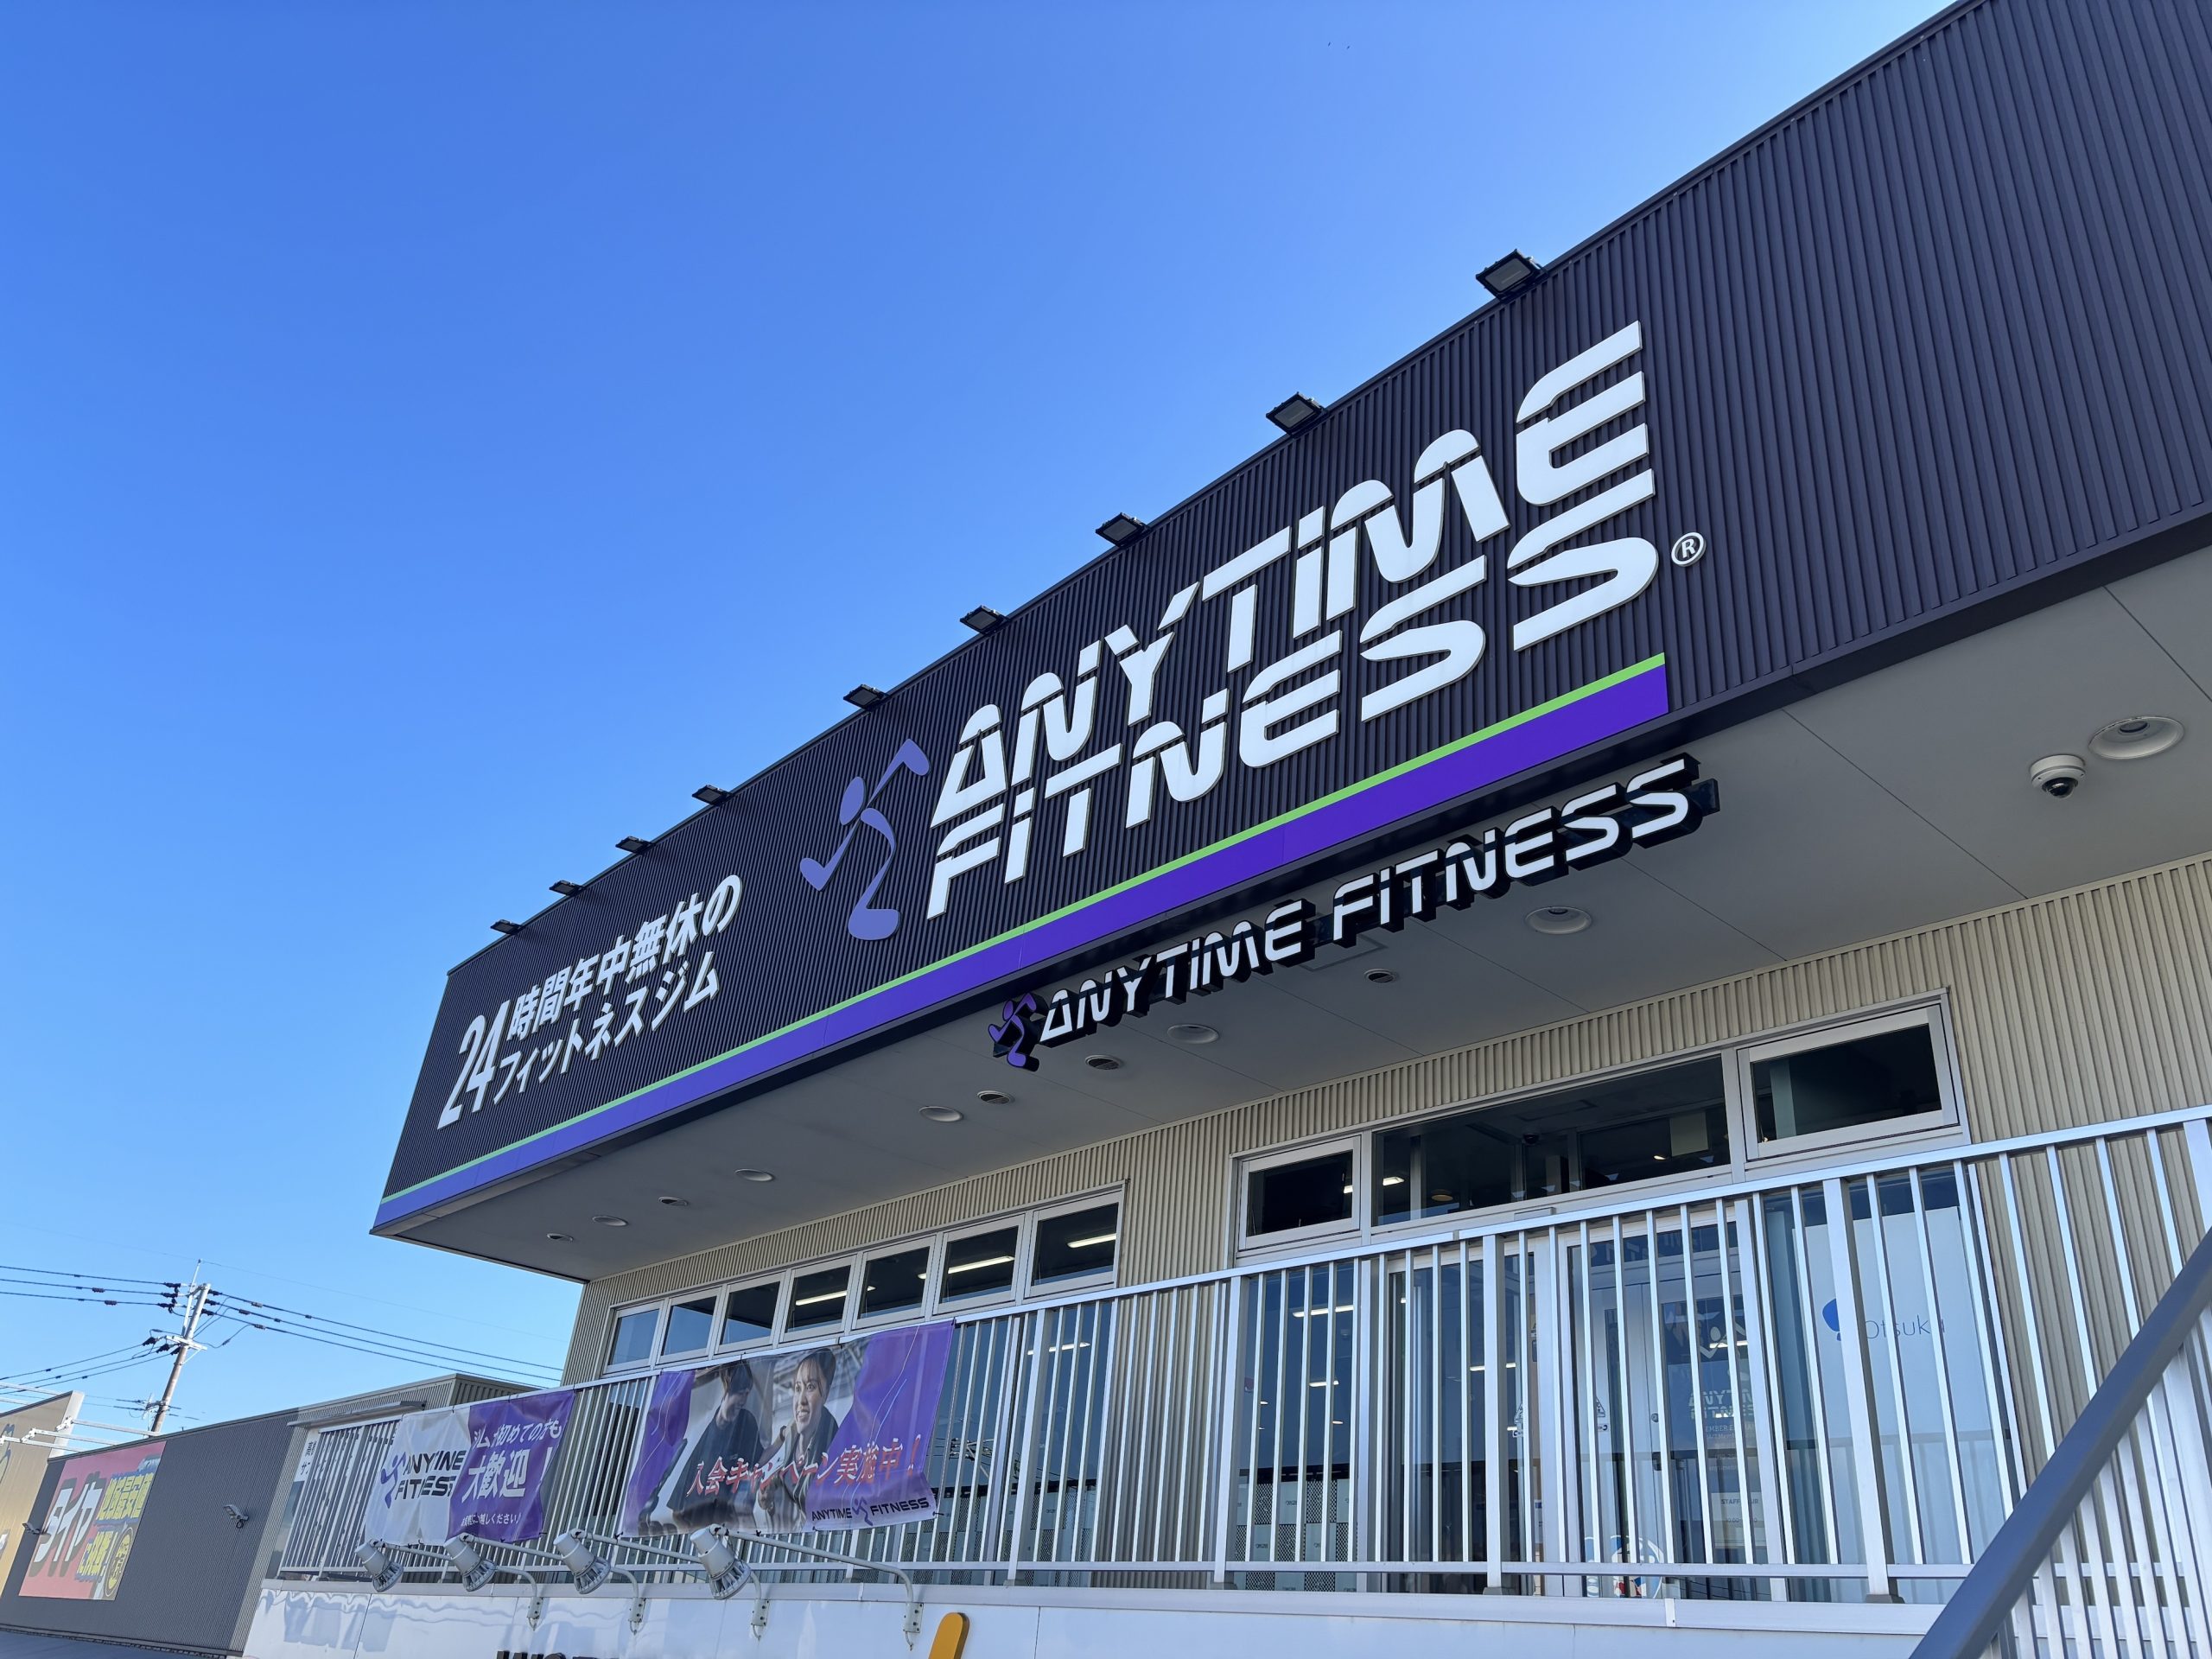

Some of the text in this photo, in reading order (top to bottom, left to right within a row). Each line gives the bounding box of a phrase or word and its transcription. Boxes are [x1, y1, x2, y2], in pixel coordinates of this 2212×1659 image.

[931, 321, 1648, 828] ANYTIME
[926, 468, 1659, 920] FITNESS
[1040, 759, 1690, 1042] ANYTIME FITNESS
[493, 951, 720, 1105] フィットネスジム
[1866, 1314, 1945, 1339] Otsuk
[33, 1481, 103, 1563] タイヤ
[812, 1497, 931, 1521] ANYTIME FITNESS
